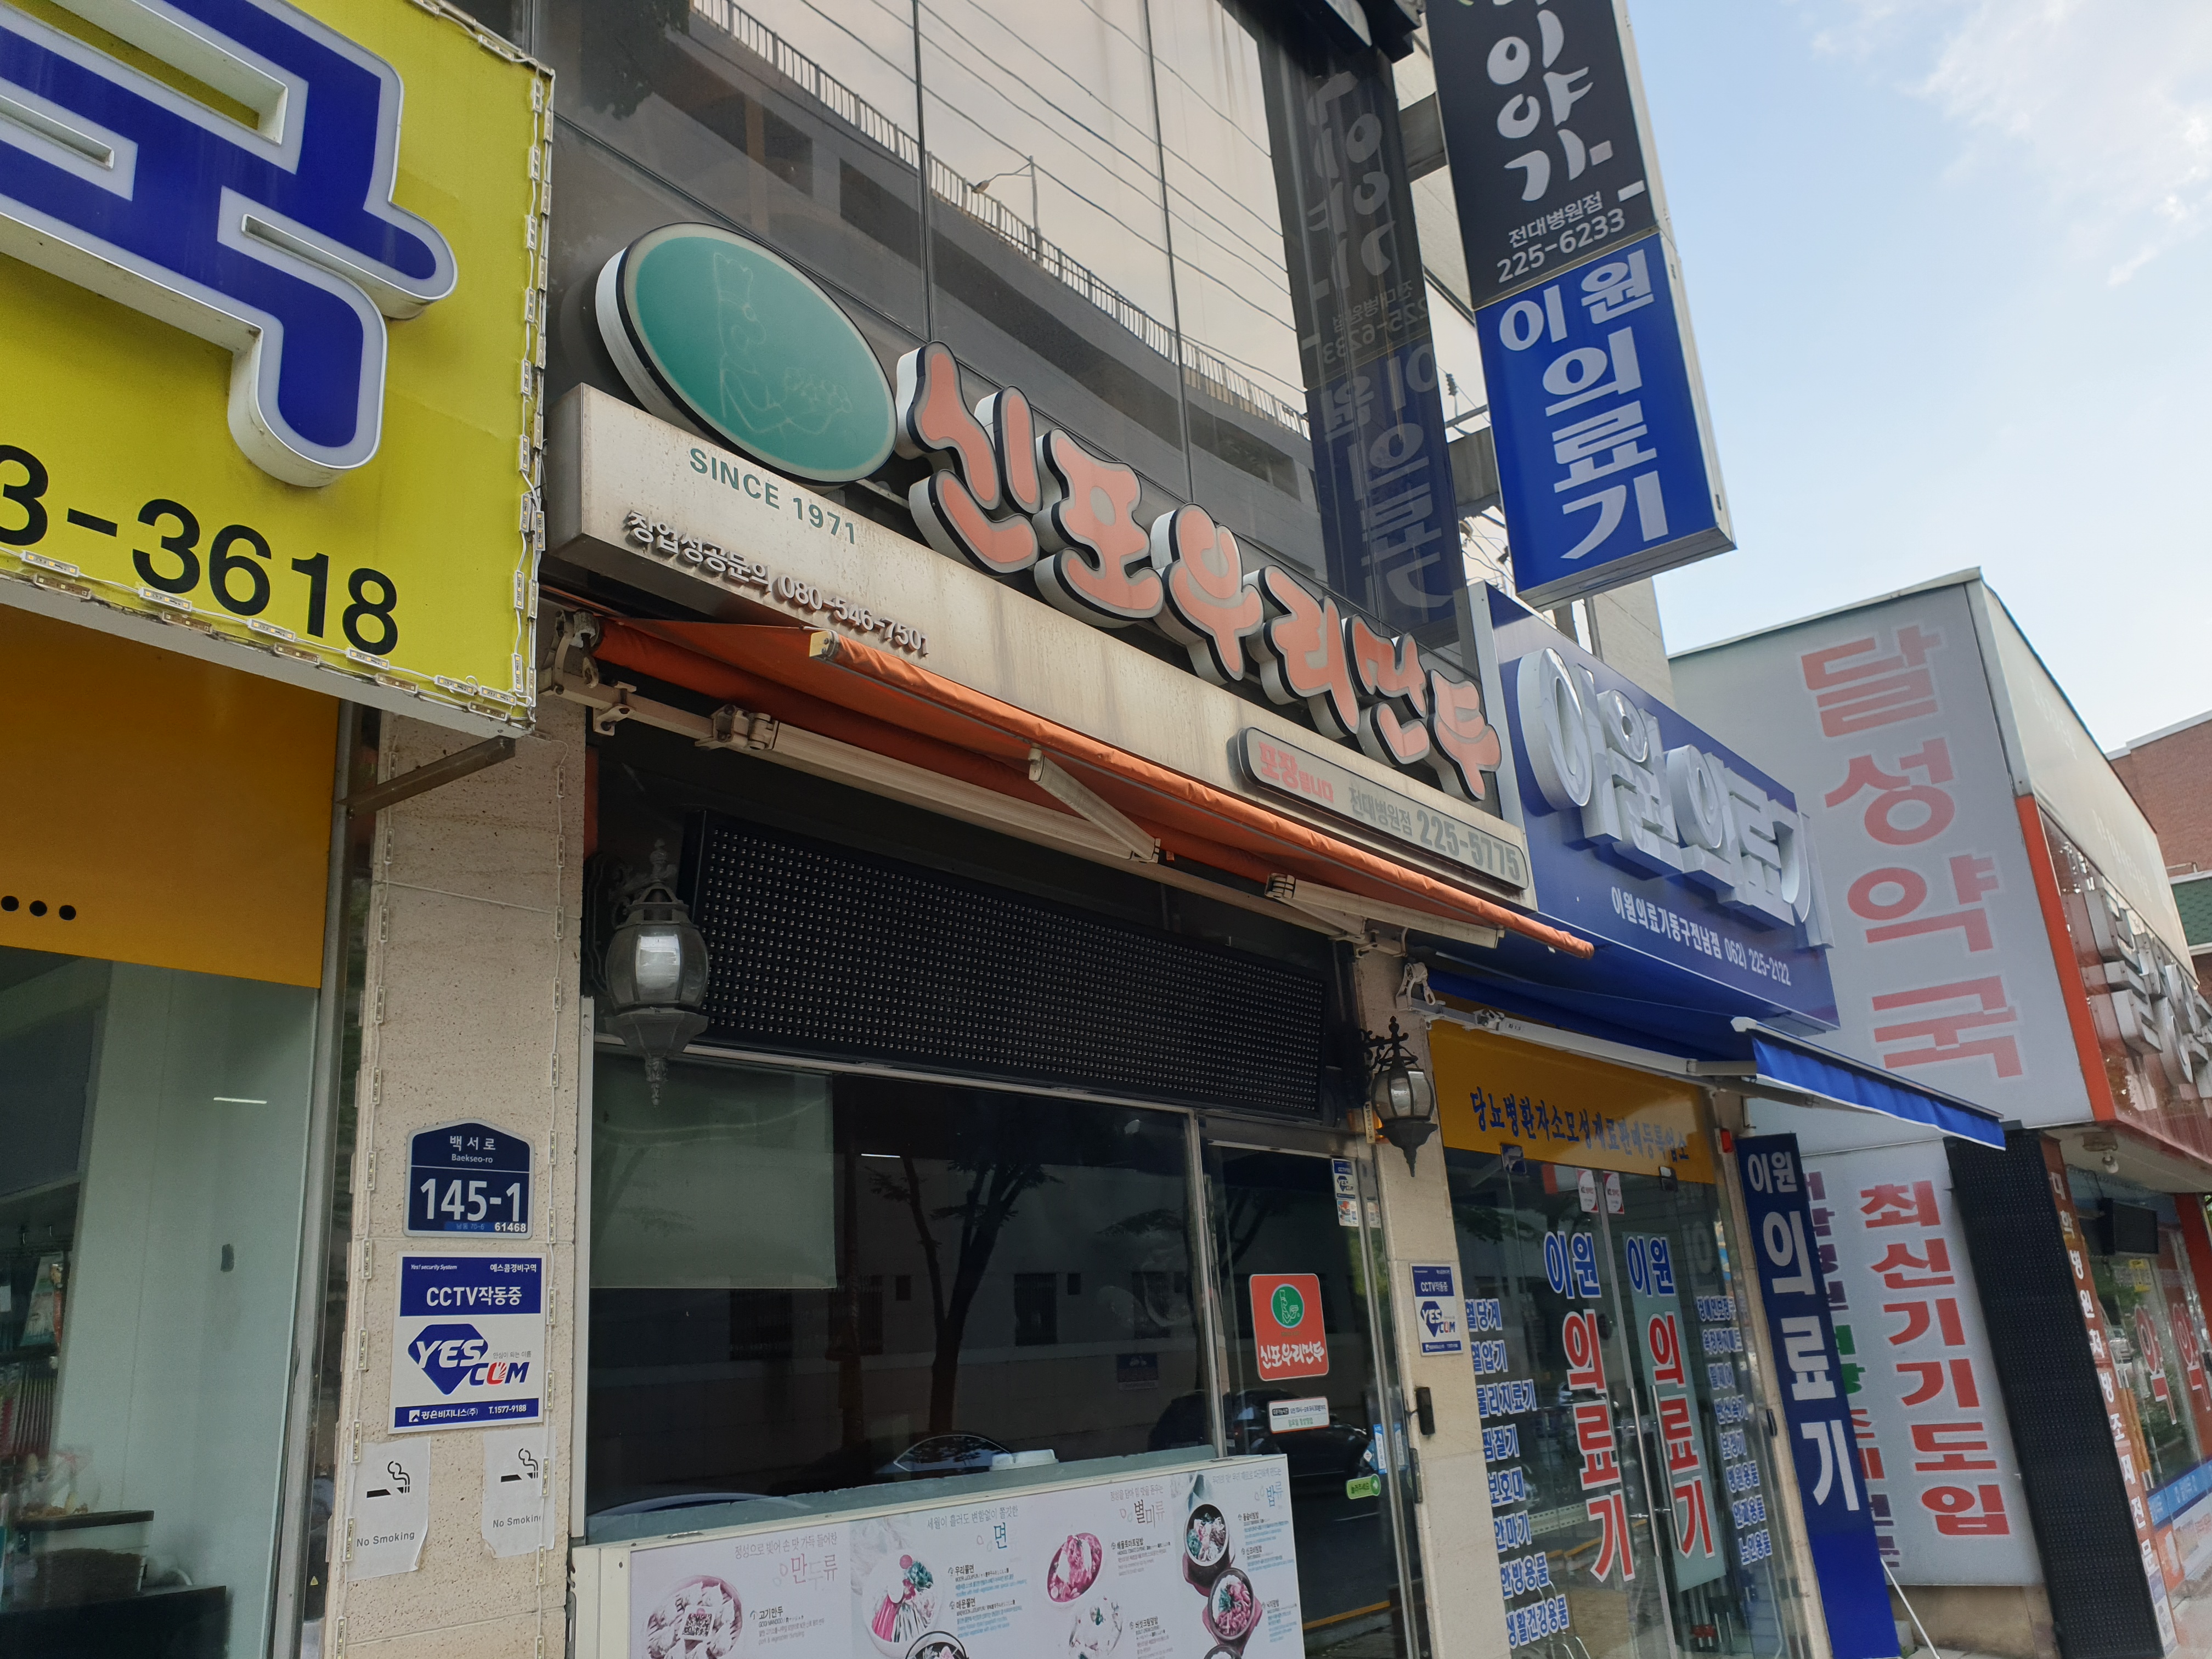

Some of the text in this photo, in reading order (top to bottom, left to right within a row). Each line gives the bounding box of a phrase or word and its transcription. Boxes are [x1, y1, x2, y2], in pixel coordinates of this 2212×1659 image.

[1508, 191, 1604, 248] 전대병원점
[1497, 208, 1626, 284] 225-6233
[1498, 249, 1654, 351] 이원
[1542, 326, 1669, 560] 의료기
[690, 447, 855, 545] SINCE 1971
[0, 445, 399, 656] 3-3618
[900, 340, 1502, 802] 신포우리만두
[627, 510, 929, 658] 창업성공문의 080-546-7501
[1517, 647, 1835, 949] 이원의료기
[1348, 786, 1413, 837] 전대병원점
[1417, 809, 1521, 881] 225-5775
[1801, 624, 2023, 1079] 달성약국
[1724, 937, 1747, 970] 062)
[1748, 947, 1792, 986] 225-2122
[449, 1135, 496, 1152] 백서로
[451, 1153, 494, 1164] Baekseo-ro
[1747, 1153, 1798, 1194] 이원
[420, 1178, 521, 1222] 145-1
[494, 1222, 527, 1233] 61468
[489, 1263, 537, 1273] 예스콤경비구역
[1543, 1231, 1601, 1300] 이원
[1626, 1235, 1677, 1299] 이원
[426, 1285, 522, 1307] CCTV작동중
[1422, 1308, 1442, 1324] YES
[1465, 1298, 1503, 1332] 혈당계
[415, 1339, 486, 1369] YES
[469, 1361, 531, 1387] COM
[1260, 1341, 1325, 1369] 신포우리만두
[1762, 1210, 1859, 1513] 의료기
[1860, 1180, 2010, 1536] 최신기기도입
[488, 1404, 527, 1414] T.1577-9188
[1476, 1378, 1537, 1419] 물리치료기
[1482, 1423, 1520, 1463] 찜질기
[1562, 1308, 1636, 1583] 의료기
[1647, 1310, 1716, 1559] 의료기
[1487, 1466, 1526, 1508] 보호대
[356, 1531, 415, 1548] No Smoking
[492, 1519, 505, 1528] No
[1493, 1509, 1532, 1554] 안마기
[735, 1543, 765, 1560] 정성으로
[791, 1553, 838, 1590] 만두류
[1499, 1551, 1550, 1600] 한방용품
[758, 1606, 784, 1620] 고기만두
[1506, 1593, 1570, 1650] 생활건강용품
